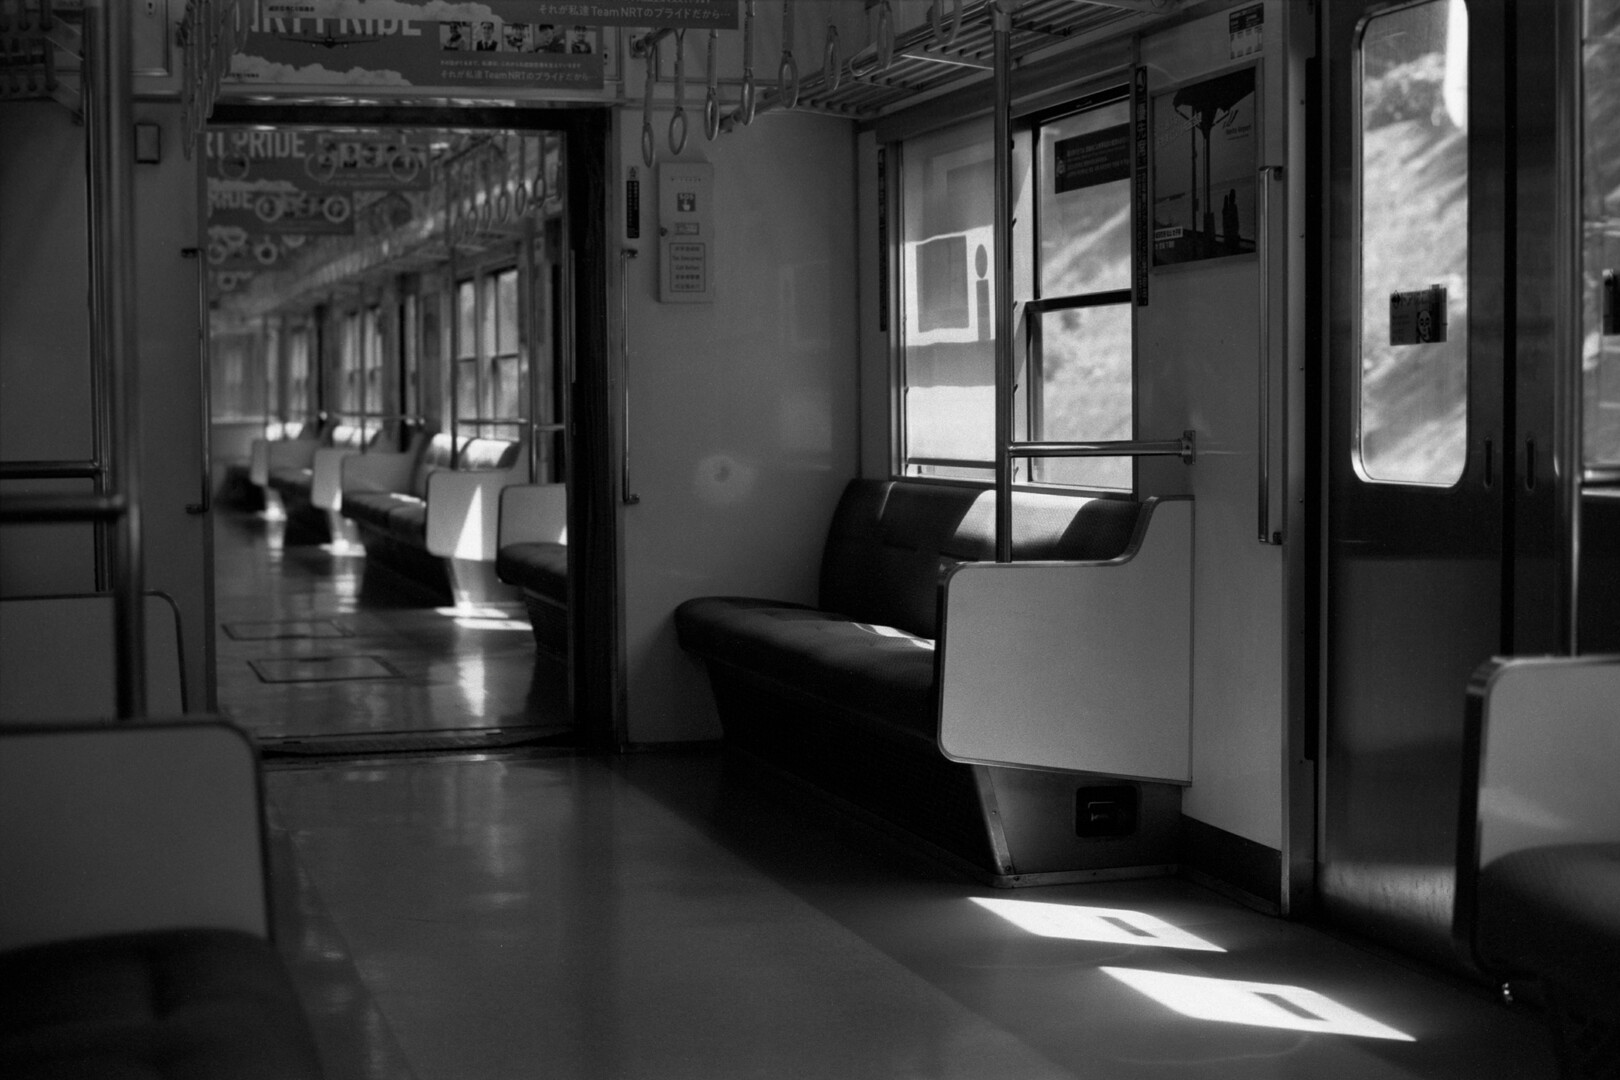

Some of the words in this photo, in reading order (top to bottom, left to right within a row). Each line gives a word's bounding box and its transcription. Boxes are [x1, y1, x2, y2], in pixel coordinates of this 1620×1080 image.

[538, 5, 589, 16] それが私達
[590, 6, 619, 17] Team
[484, 70, 507, 80] Team
